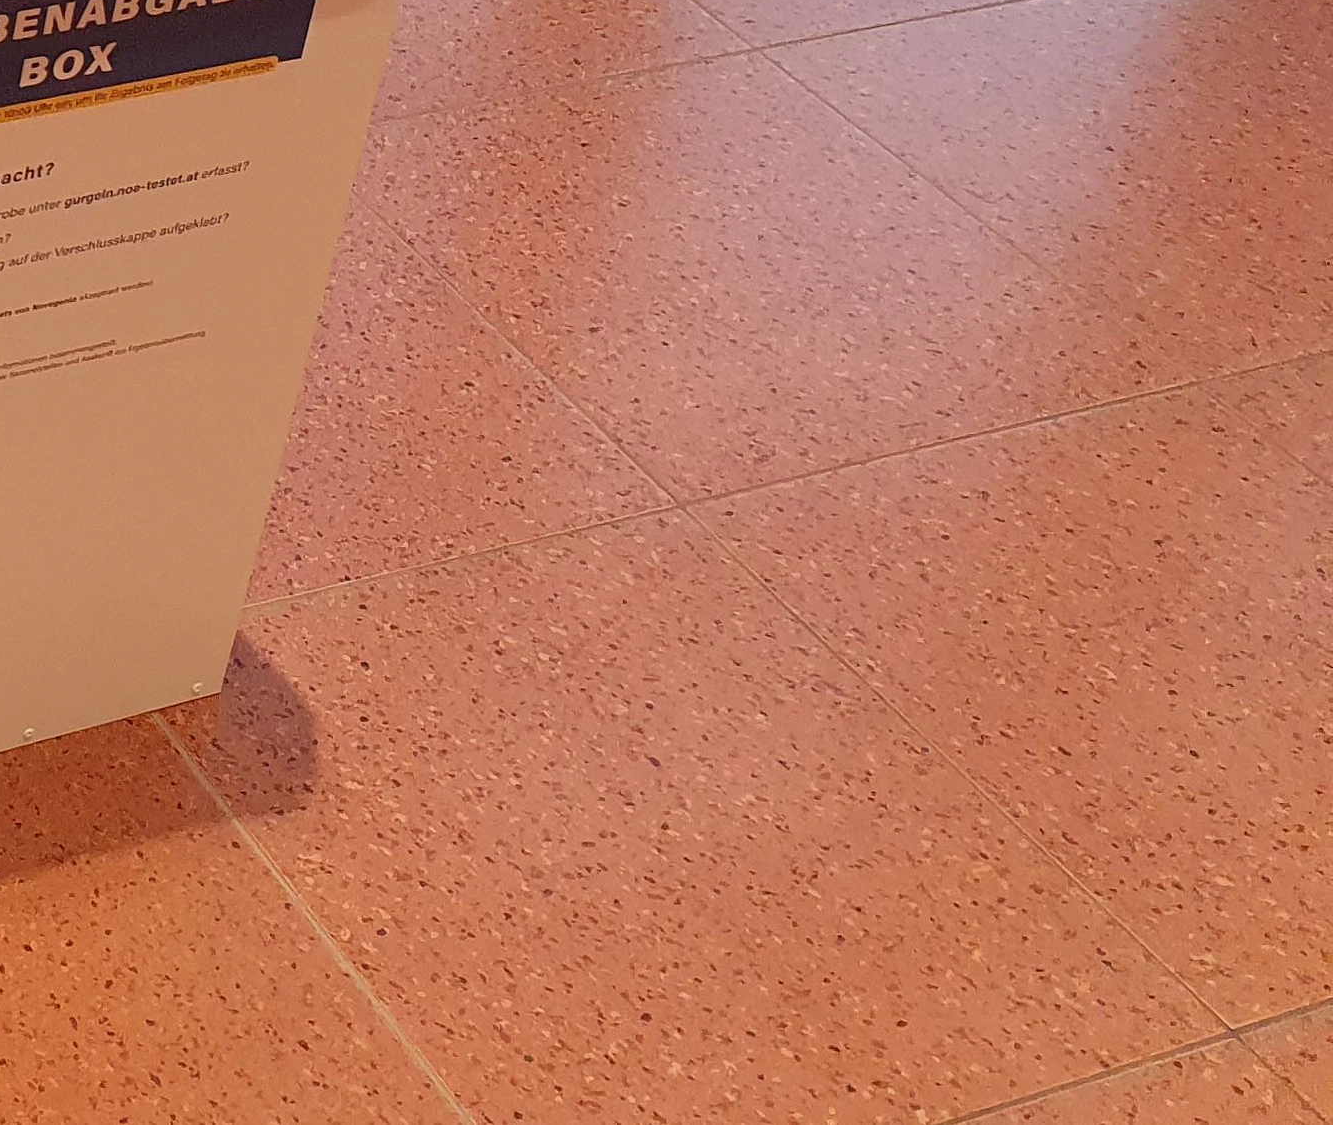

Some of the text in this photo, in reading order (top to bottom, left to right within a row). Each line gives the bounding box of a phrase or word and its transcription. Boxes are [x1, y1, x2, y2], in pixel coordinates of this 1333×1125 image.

[19, 42, 117, 87] BOX
[29, 200, 62, 214] unter
[64, 171, 199, 209] gurgeln.noe-testet.at
[201, 160, 250, 179] erfasst?
[8, 253, 29, 267] auf
[30, 251, 52, 262] der
[54, 230, 156, 256] Verschlusskappe
[159, 212, 229, 236] aufgeklebt?
